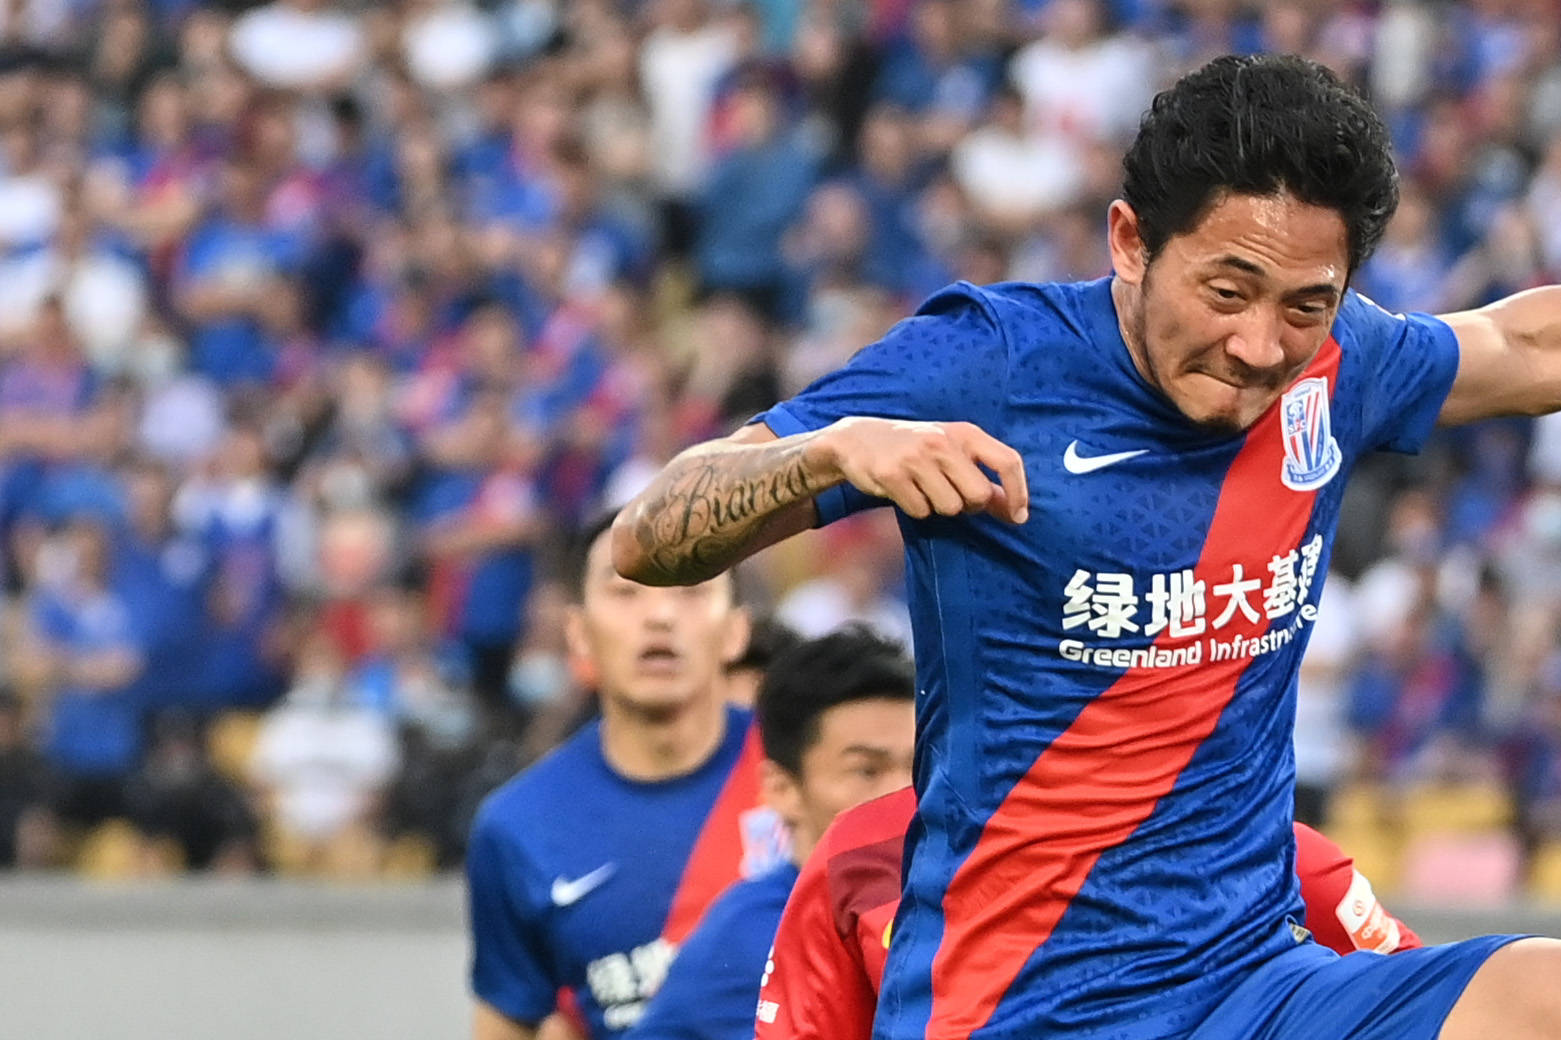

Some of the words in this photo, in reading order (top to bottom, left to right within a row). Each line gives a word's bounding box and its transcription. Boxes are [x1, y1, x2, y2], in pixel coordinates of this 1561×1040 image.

[1062, 533, 1322, 638] 绿地大基建
[1059, 639, 1202, 667] Greenland
